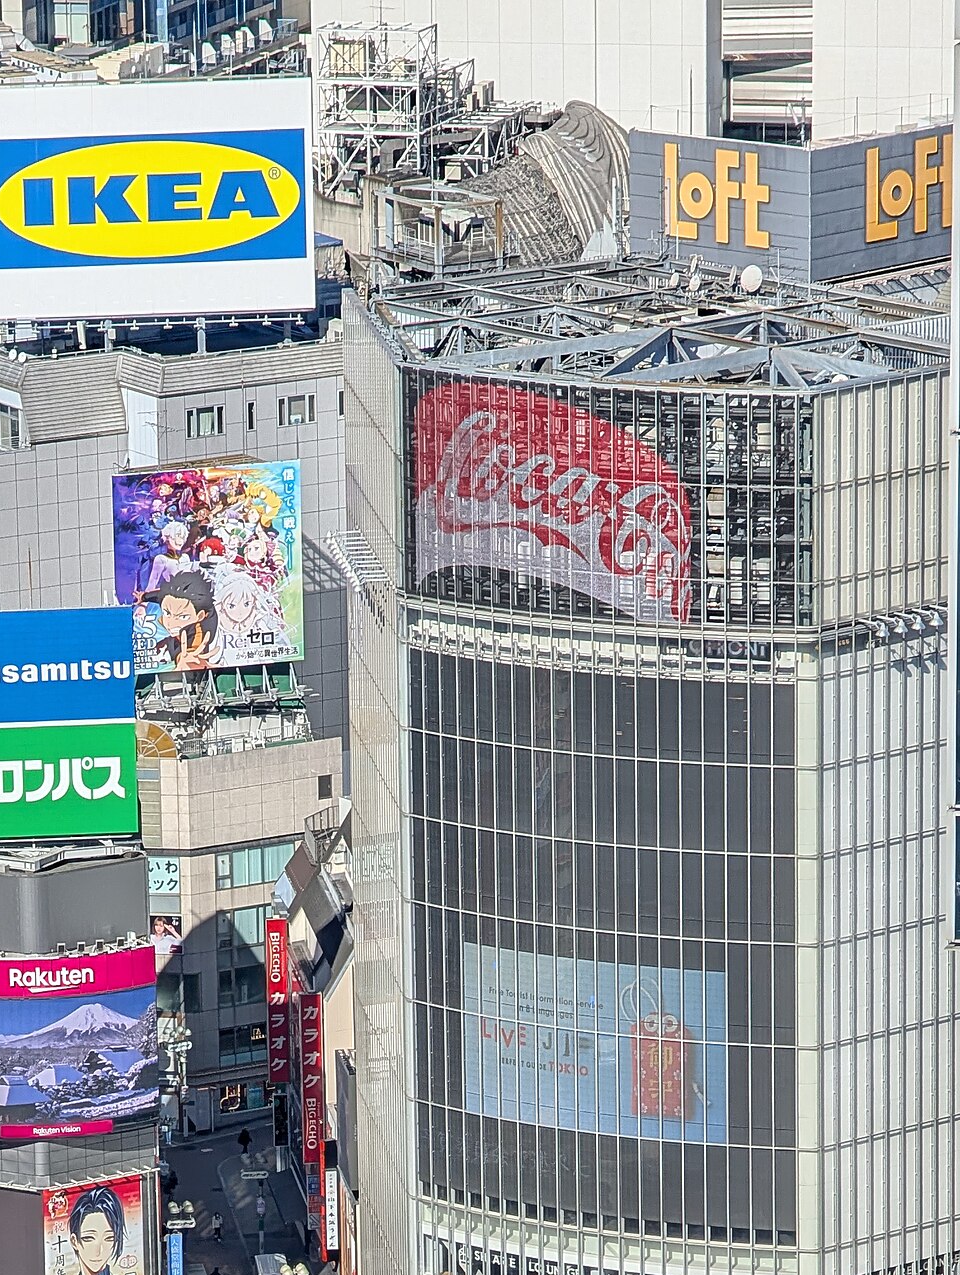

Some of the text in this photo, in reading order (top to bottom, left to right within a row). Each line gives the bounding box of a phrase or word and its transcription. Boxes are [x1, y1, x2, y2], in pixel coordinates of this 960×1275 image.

[22, 169, 280, 226] IKEA
[224, 629, 274, 650] Re:ゼロ
[149, 877, 178, 891] ック
[9, 966, 95, 988] Rakuten
[269, 932, 281, 983] BIG ECHO
[270, 992, 287, 1072] カラオケ
[303, 1006, 321, 1089] カラオケ
[33, 1124, 81, 1136] Rakuten Vision
[305, 1098, 318, 1150] BIG ECHO
